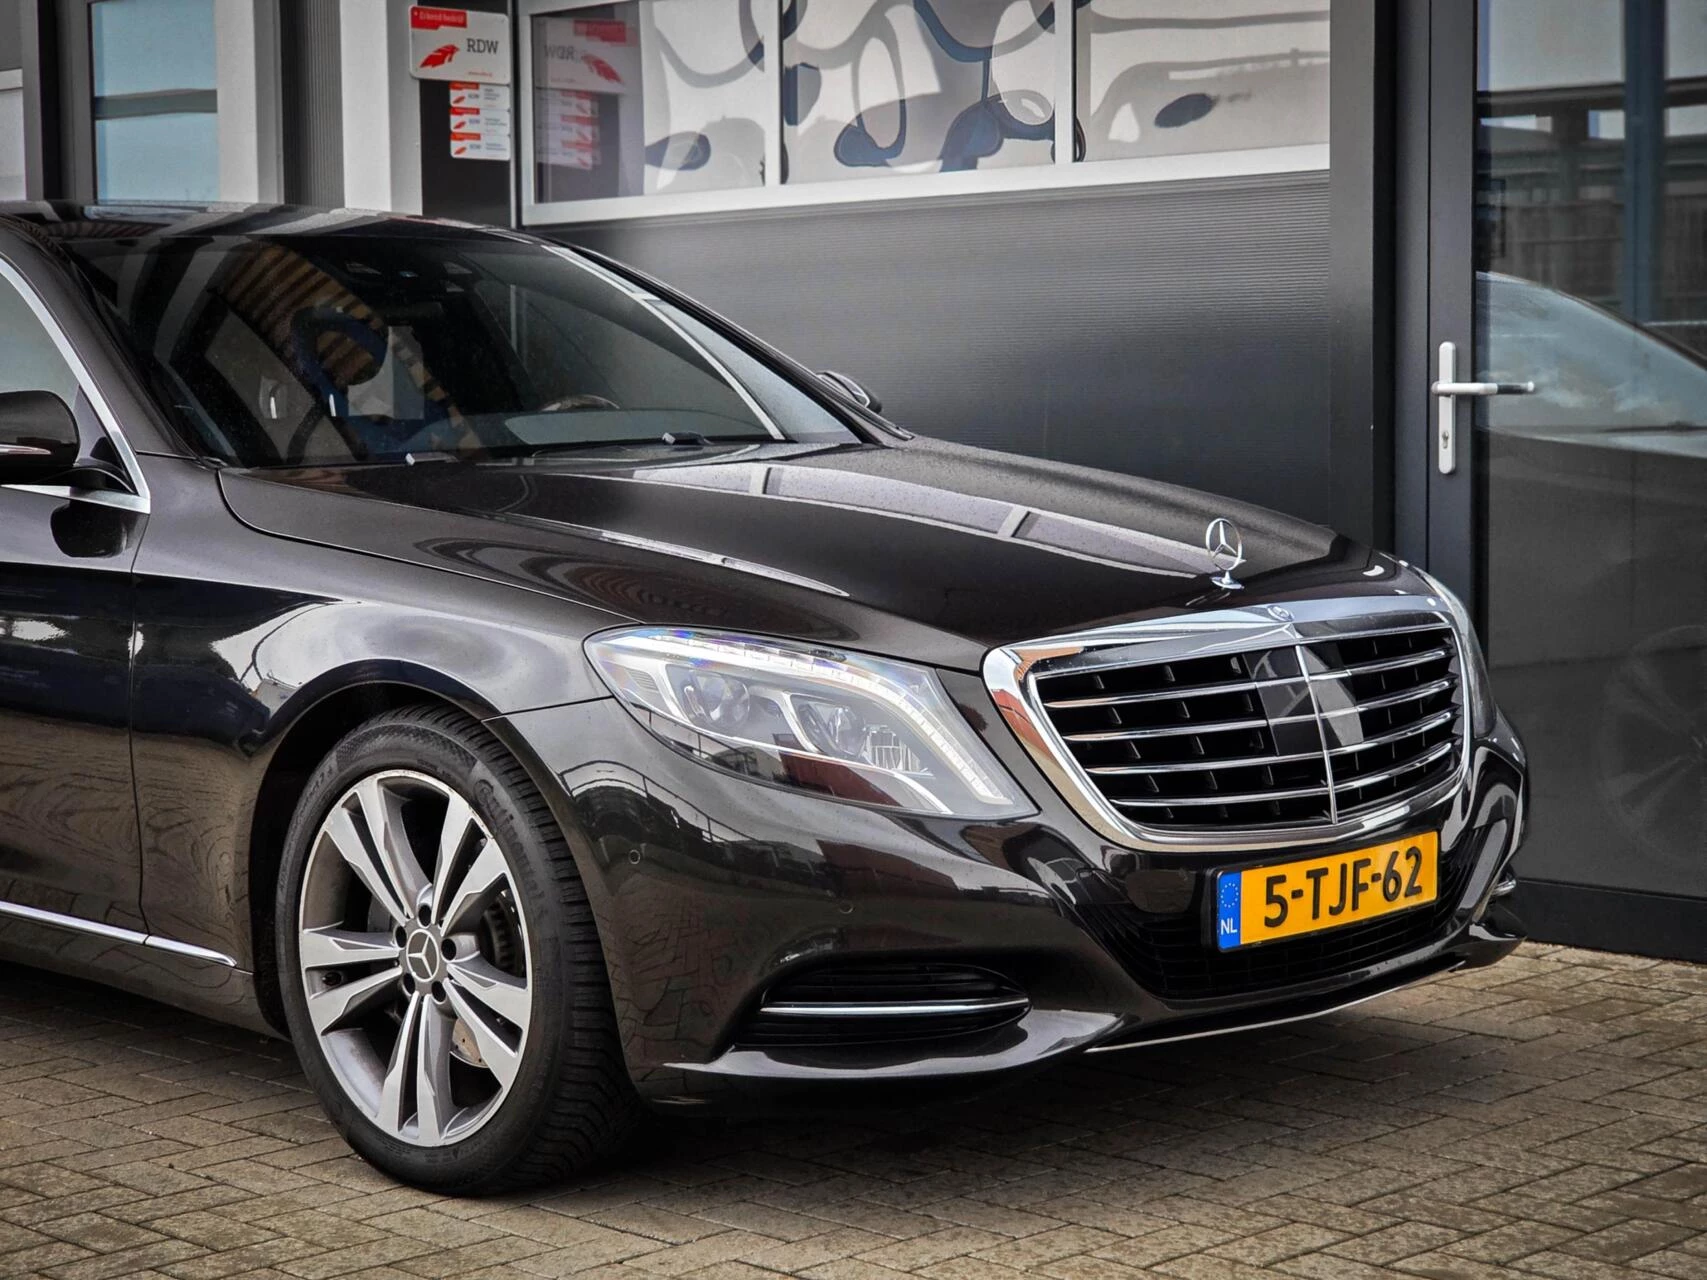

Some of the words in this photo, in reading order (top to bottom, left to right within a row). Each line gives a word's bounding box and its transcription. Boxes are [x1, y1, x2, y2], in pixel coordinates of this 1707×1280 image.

[466, 38, 499, 54] RDW
[1264, 846, 1423, 928] 5-TJF-62
[1221, 918, 1238, 935] NL
